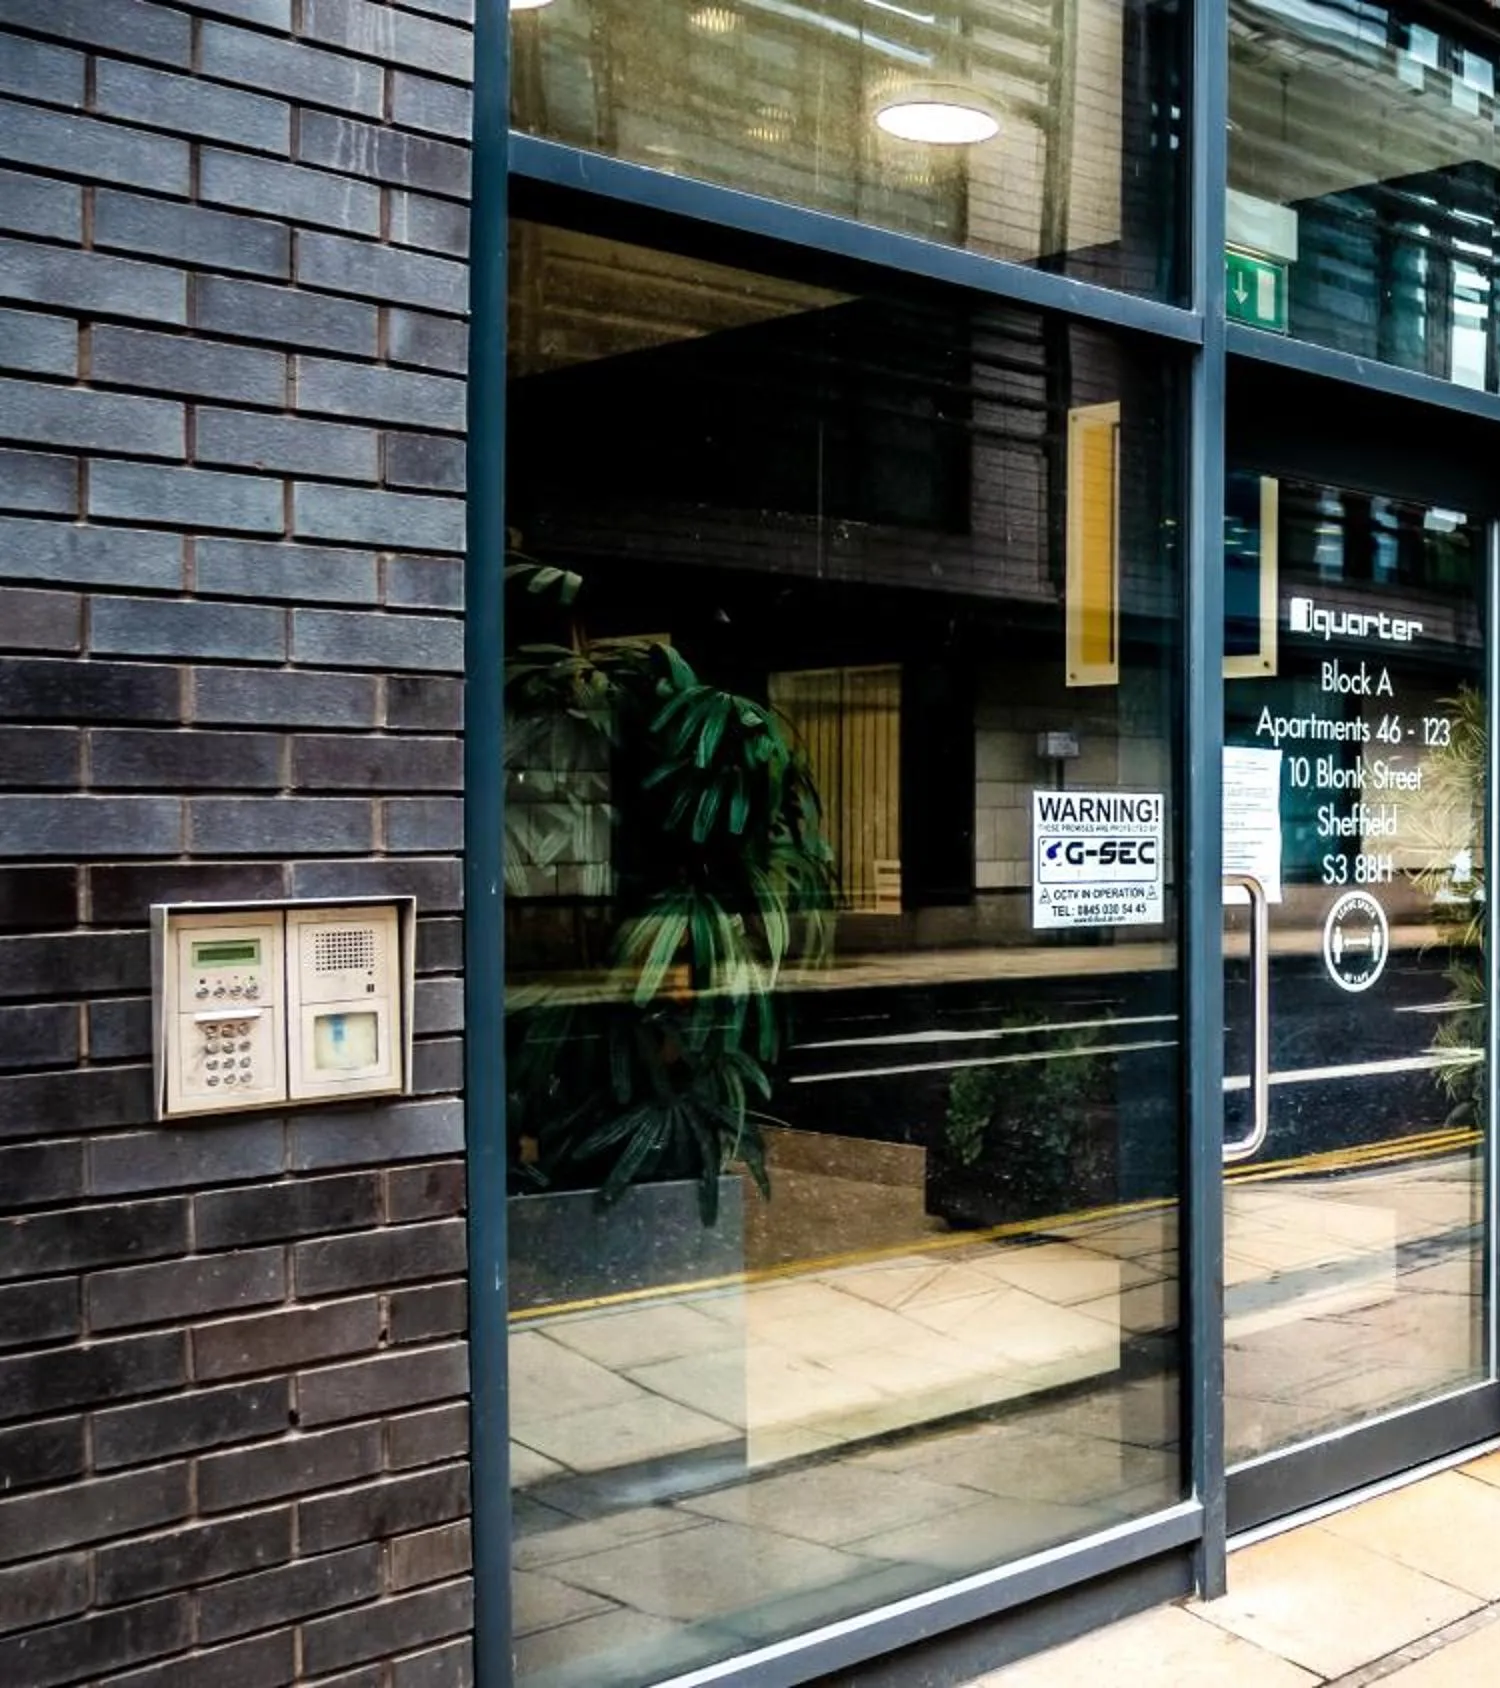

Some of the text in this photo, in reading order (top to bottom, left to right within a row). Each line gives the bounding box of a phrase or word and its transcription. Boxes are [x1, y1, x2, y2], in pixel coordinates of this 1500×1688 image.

[1321, 661, 1394, 697] Block A
[1256, 706, 1371, 747] Apartments
[1375, 716, 1402, 743] 46
[1423, 717, 1450, 747] 123
[1289, 757, 1423, 791] 10 Blonk Street
[1038, 797, 1160, 823] WARNING!
[1317, 805, 1397, 837] Sheffield
[1065, 841, 1155, 865] G-SEC
[1322, 855, 1393, 885] S3 8BH
[1053, 887, 1145, 900] CCTV IN OPERATION
[1051, 905, 1075, 917] TEL:
[1077, 904, 1100, 916] 0845
